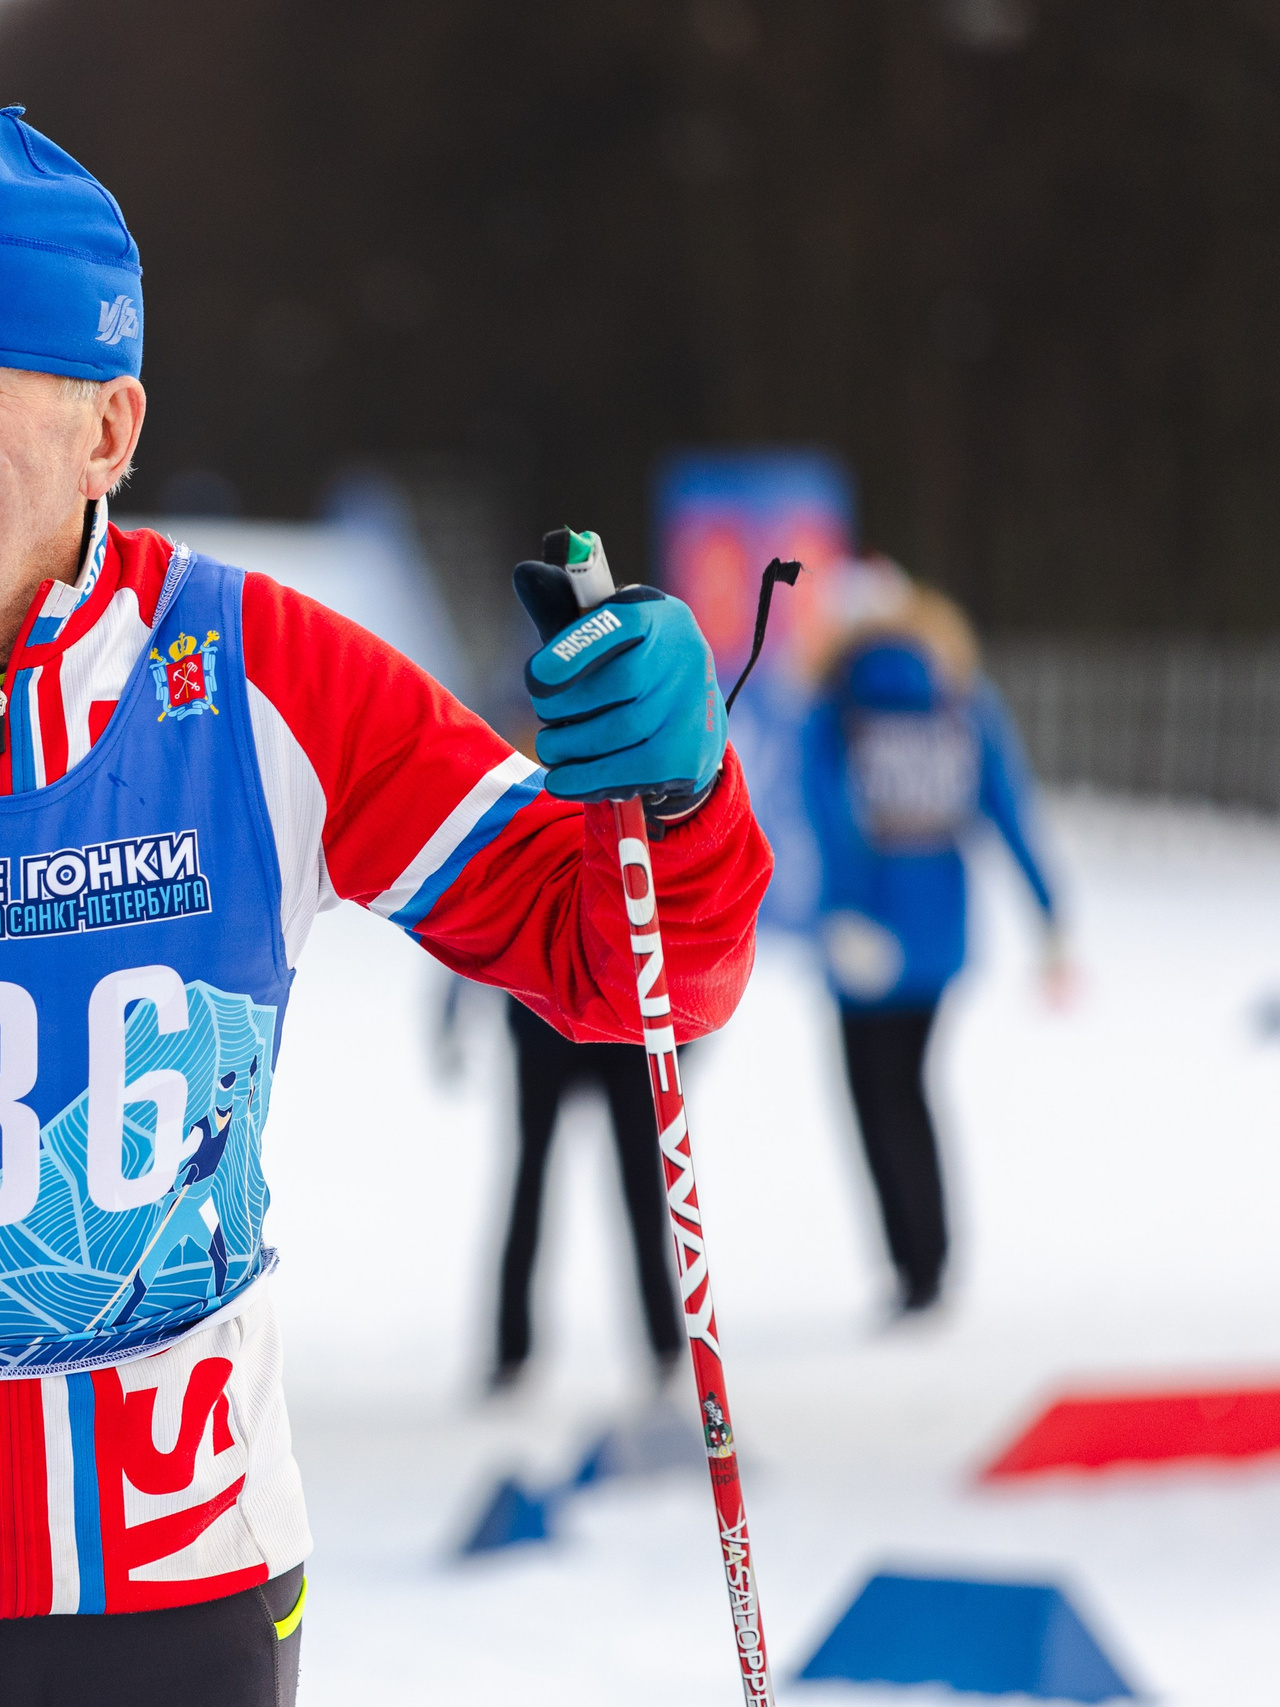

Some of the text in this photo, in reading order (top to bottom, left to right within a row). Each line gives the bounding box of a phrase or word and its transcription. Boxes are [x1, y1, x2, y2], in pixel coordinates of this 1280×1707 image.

[552, 609, 622, 662] RUSSIA
[26, 835, 197, 901] ГОНКИ
[9, 879, 206, 934] САНКТ-ПЕТЕРБУРГА
[618, 837, 722, 1361] ONE WAY
